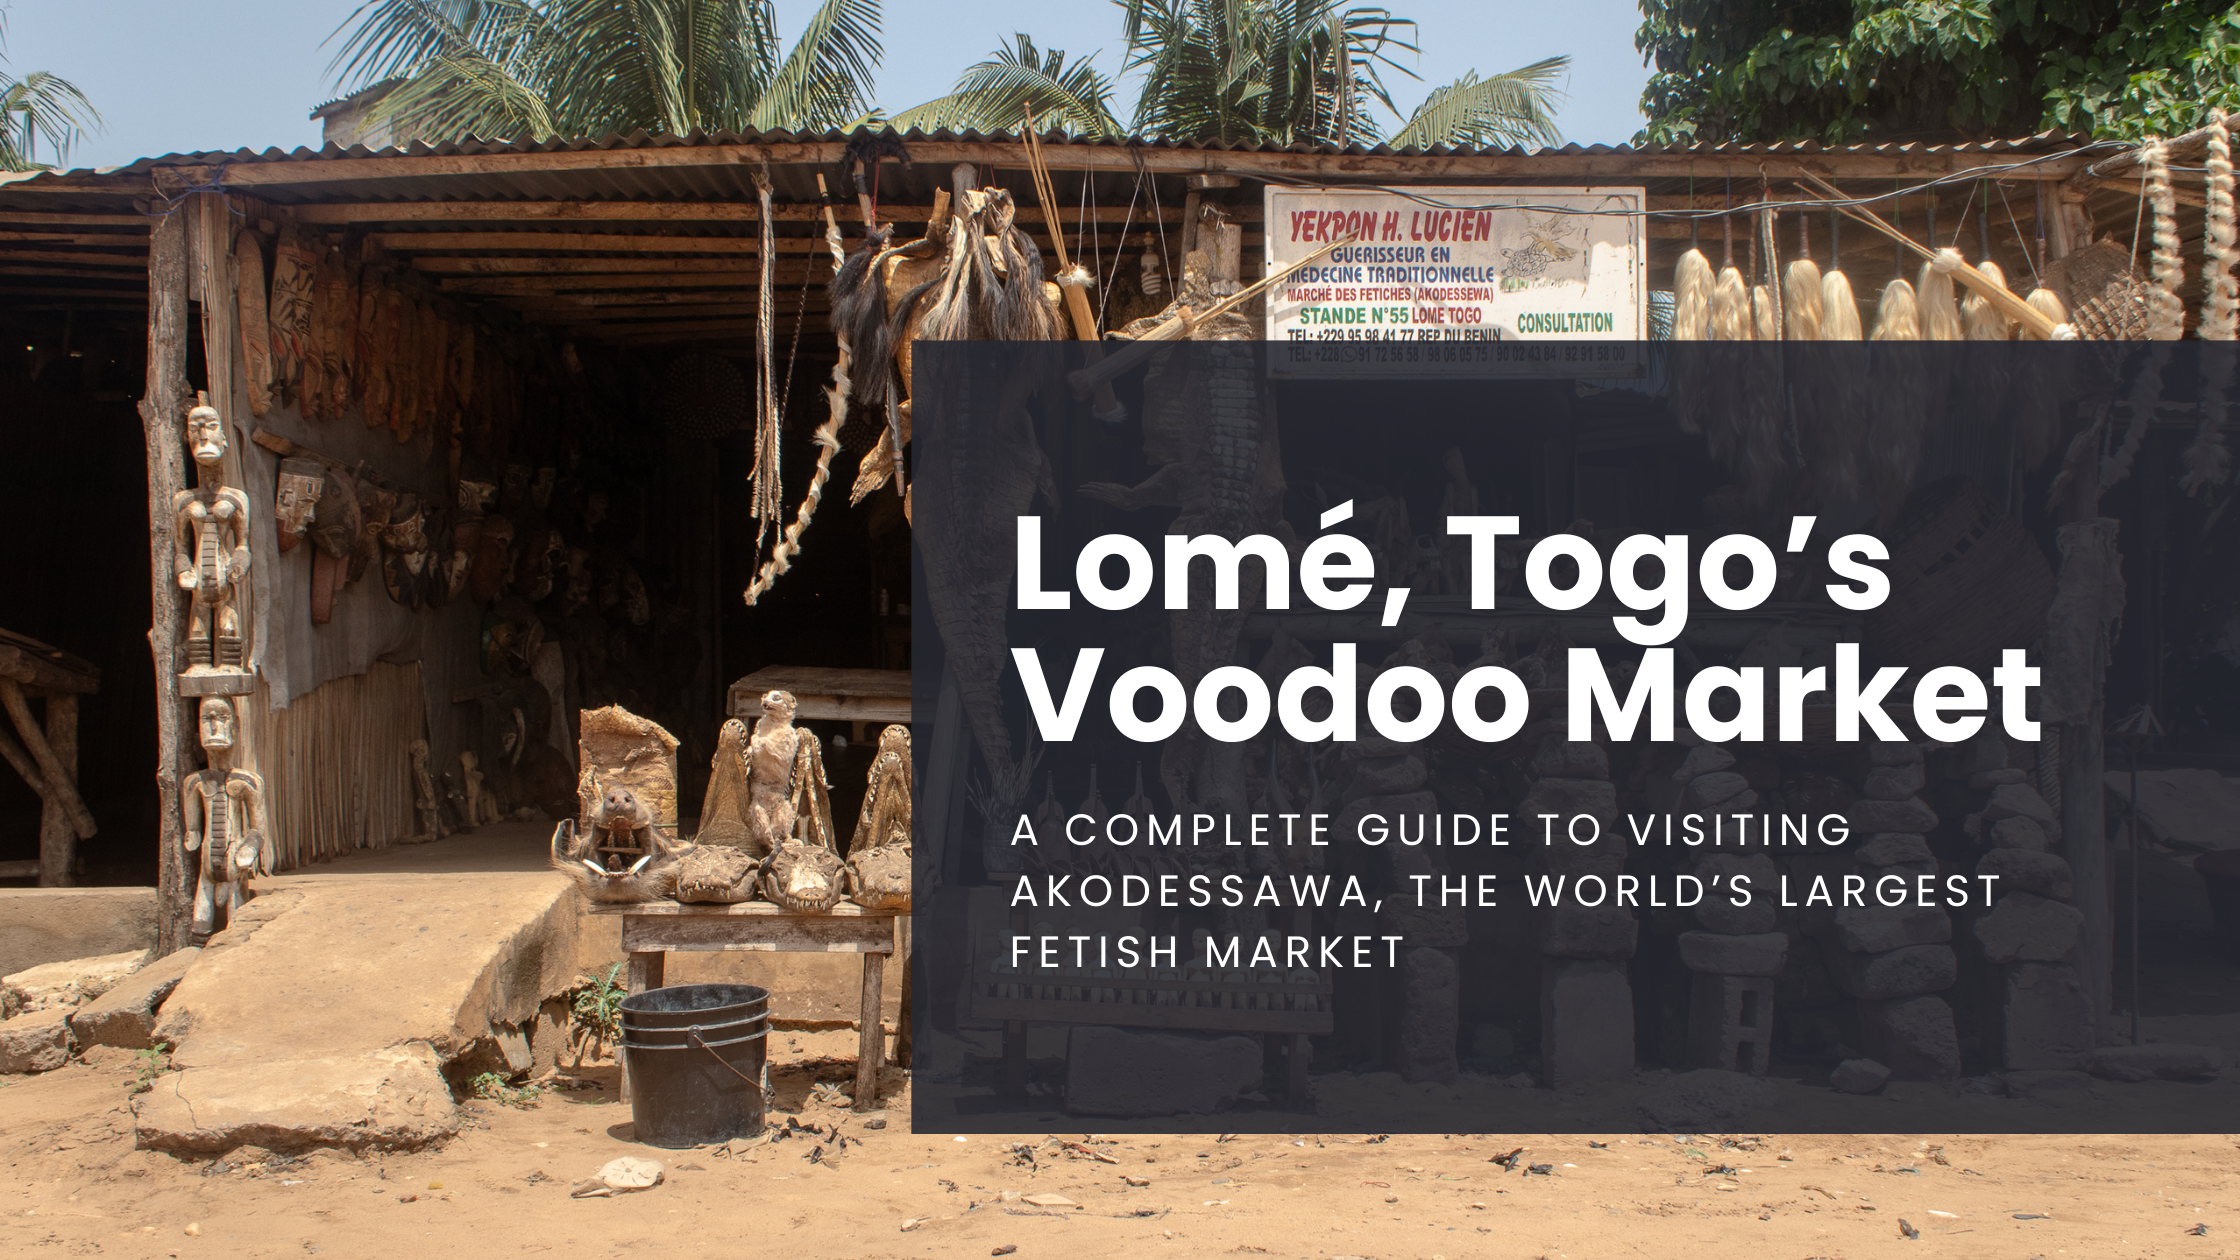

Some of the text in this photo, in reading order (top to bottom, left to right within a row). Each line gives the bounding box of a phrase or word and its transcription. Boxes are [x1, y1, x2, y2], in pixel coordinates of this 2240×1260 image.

[1291, 210, 1492, 244] YEKPON H. LUCIEN
[1330, 246, 1450, 264] GUERISSEUR EN
[1286, 266, 1494, 284] MEDECINE TRADITIONNELLE
[1287, 285, 1494, 303] MARCHÉ DES FETICHES (AKODESSEWA)
[1300, 306, 1482, 324] STANDE N°55 LOME TOGO
[1518, 312, 1613, 334] CONSULTATION
[1287, 329, 1501, 345] TEL: +229 95 98 41 77 REP DU BENIN
